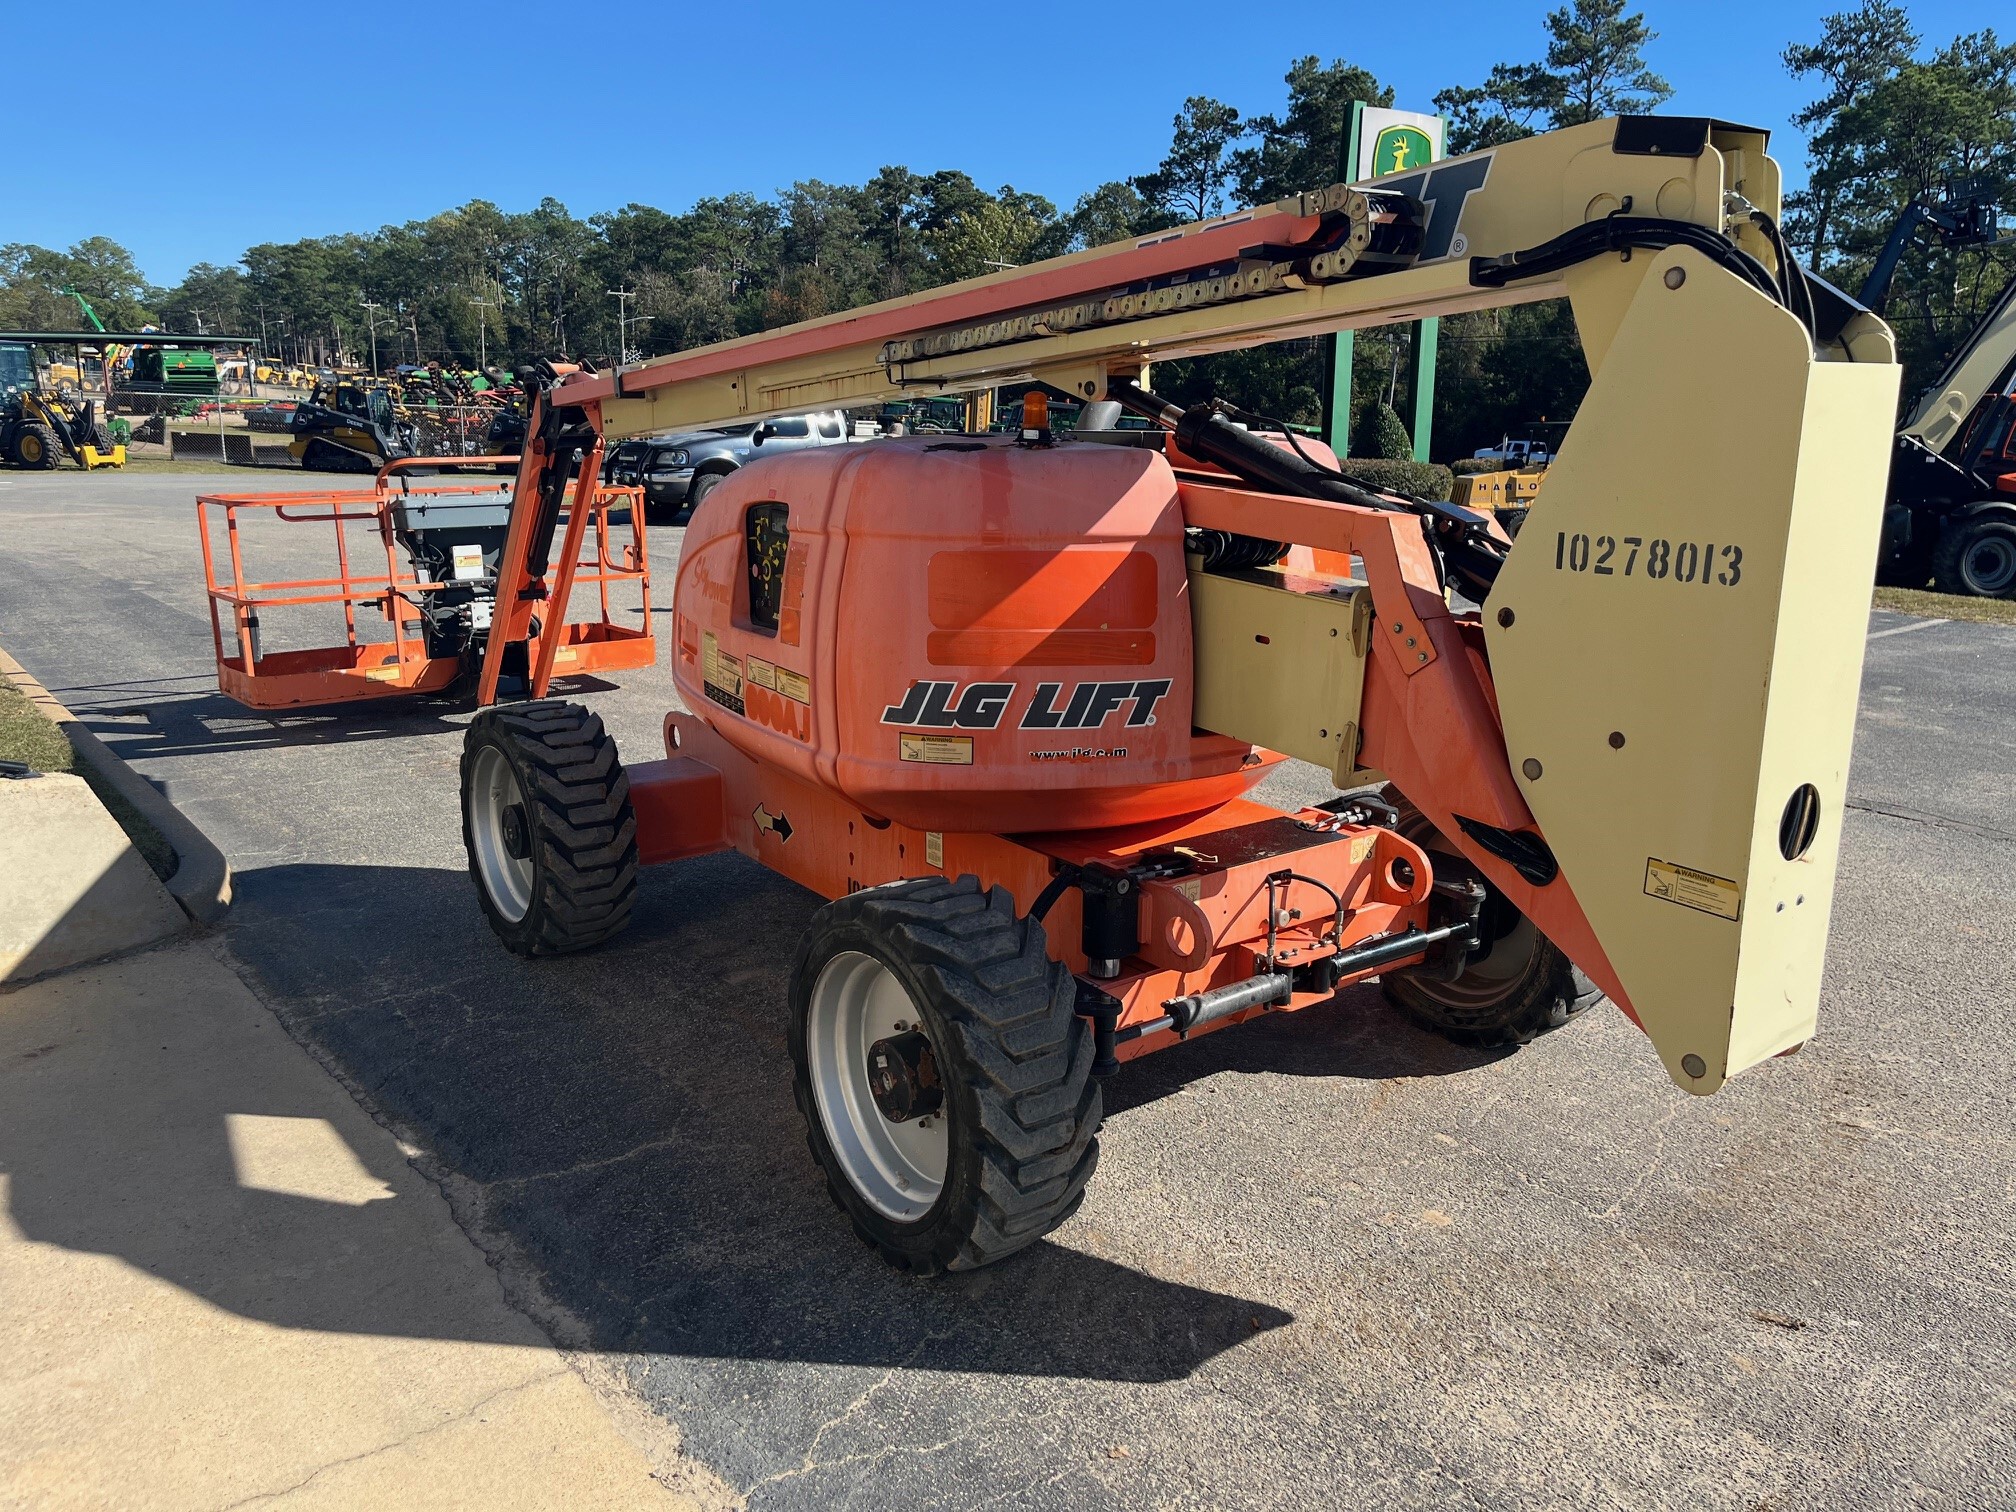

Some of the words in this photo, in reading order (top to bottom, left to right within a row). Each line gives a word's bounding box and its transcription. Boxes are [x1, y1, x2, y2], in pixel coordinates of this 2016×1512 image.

[1478, 482, 1538, 491] HARLO
[1555, 532, 1743, 587] 10278013
[879, 679, 1017, 730] JLG
[1017, 677, 1174, 730] LIFT
[1680, 868, 1716, 884] WARNING
